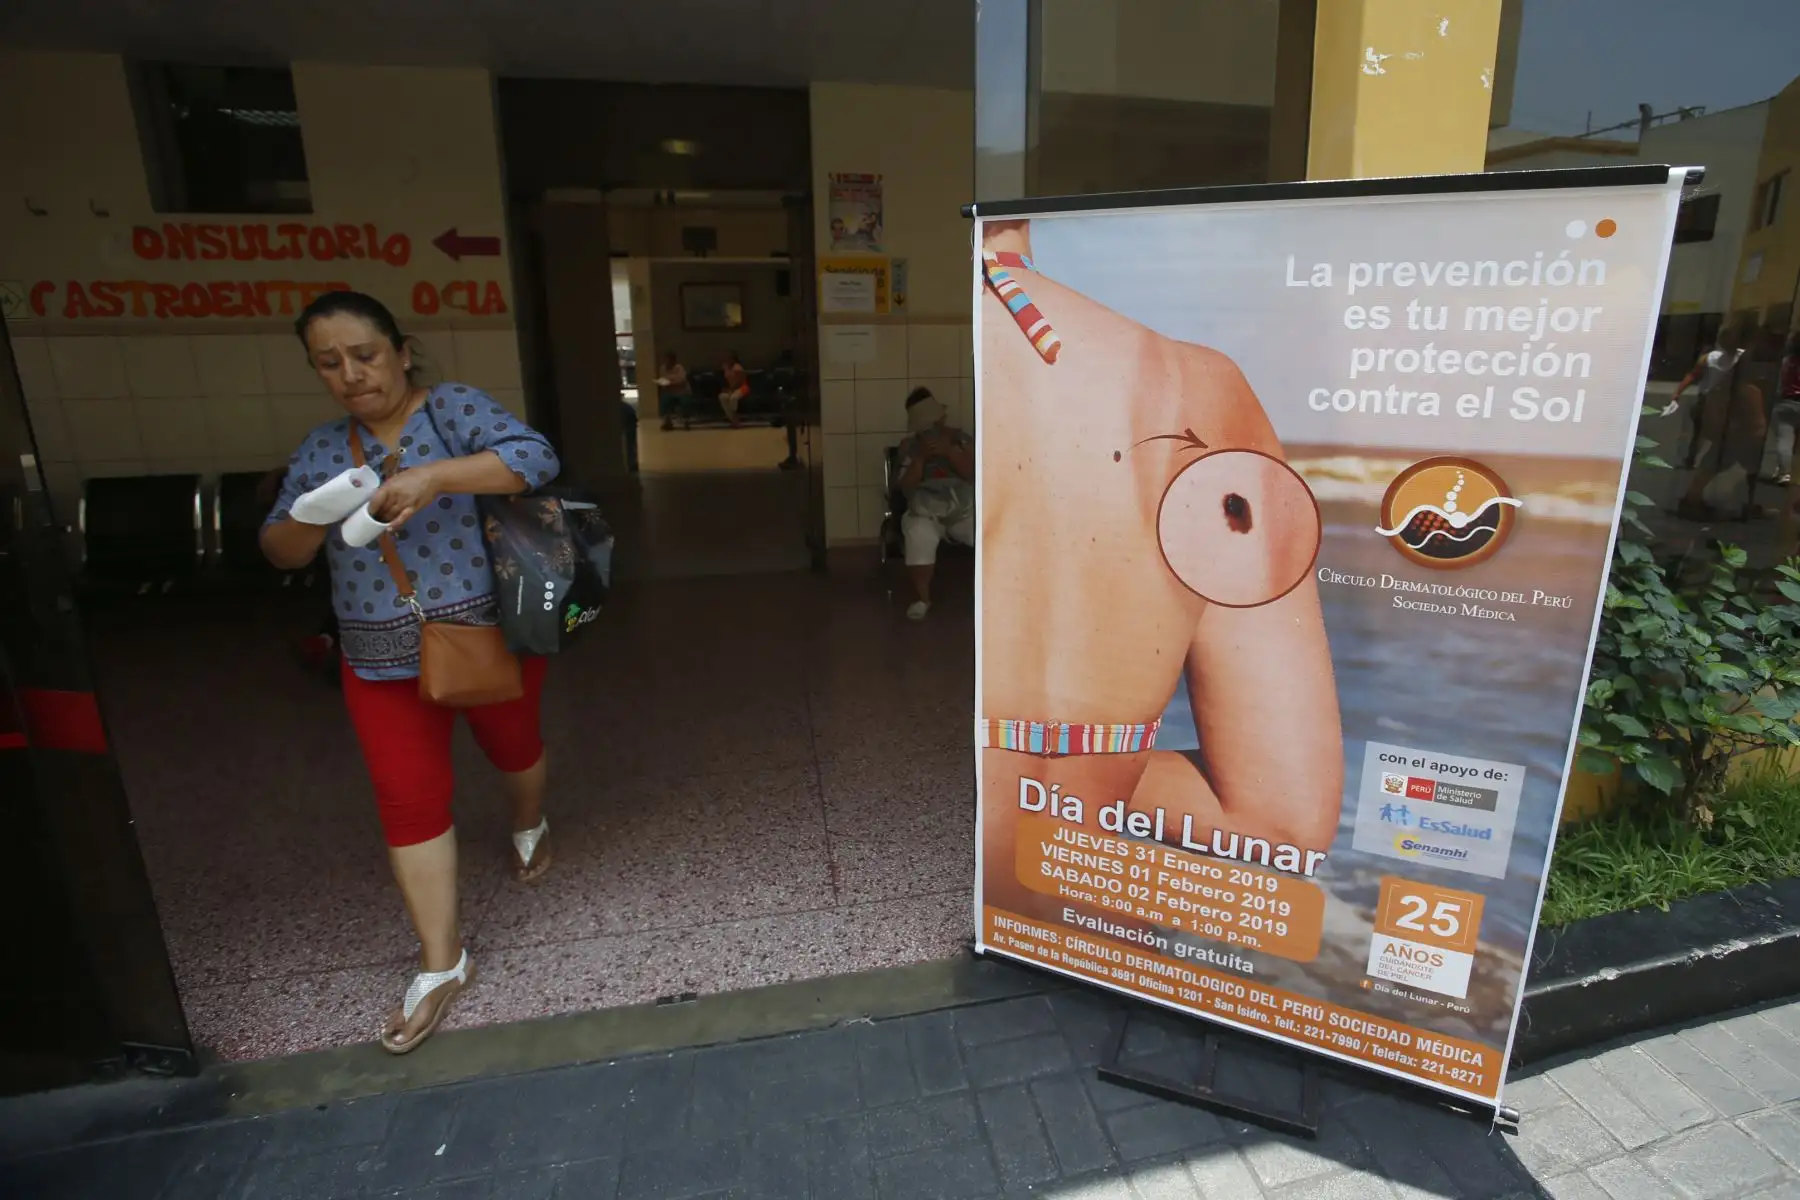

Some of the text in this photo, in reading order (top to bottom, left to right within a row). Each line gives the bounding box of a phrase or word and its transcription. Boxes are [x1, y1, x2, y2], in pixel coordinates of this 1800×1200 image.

[1286, 250, 1607, 295] La prevención
[1343, 298, 1603, 341] es tu mejor
[1349, 342, 1591, 379] protección
[1308, 384, 1586, 423] contra el Sol
[1318, 567, 1574, 609] CÍRCULO DERMATOLÓGICO DEL PERÚ
[1392, 595, 1516, 622] SOCIEDAD MÉDICA
[1379, 753, 1509, 782] con el apoyo de:
[1410, 784, 1432, 795] PERÚ
[1436, 793, 1474, 805] de Salud
[1437, 786, 1482, 799] Ministerio
[1018, 776, 1328, 878] Día del Lunar
[1418, 816, 1493, 841] EsSalud
[1053, 826, 1278, 893] JUEVES 31 Enero 2019
[1400, 839, 1468, 859] Senamhi
[1040, 842, 1291, 918] VIERNES 01 Febrero 2019
[1040, 862, 1289, 938] SABADO 02 Febrero 2019
[1059, 883, 1263, 949] Hora: 9:00 a.m a 1:00 p.m.
[1395, 895, 1461, 937] 25
[1063, 907, 1255, 975] Evaluación gratuita
[1382, 942, 1444, 968] AÑOS
[1379, 963, 1394, 972] DEL
[1390, 972, 1409, 982] PIEL
[993, 931, 1007, 945] Av.
[1008, 937, 1036, 954] Paseo
[1037, 944, 1050, 958] de
[1051, 948, 1061, 962] la
[1062, 951, 1109, 977] República
[1139, 974, 1175, 995] Oficina
[1177, 986, 1203, 1004] 1201
[1214, 997, 1234, 1014] San
[1237, 1004, 1271, 1025] Isidro.
[1304, 1024, 1361, 1052] 221-7990
[1372, 1043, 1418, 1068] Telefax:
[1421, 1058, 1484, 1087] 221-8271
[994, 915, 1484, 1068] INFORMES: CÍRCULO DERMATOLOGICO DEL PERÚ SOCIEDAD MÉDICA
[1374, 983, 1390, 994] Día
[1392, 986, 1408, 999] del
[1410, 991, 1440, 1006] Lunar
[1446, 1001, 1471, 1014] Perú
